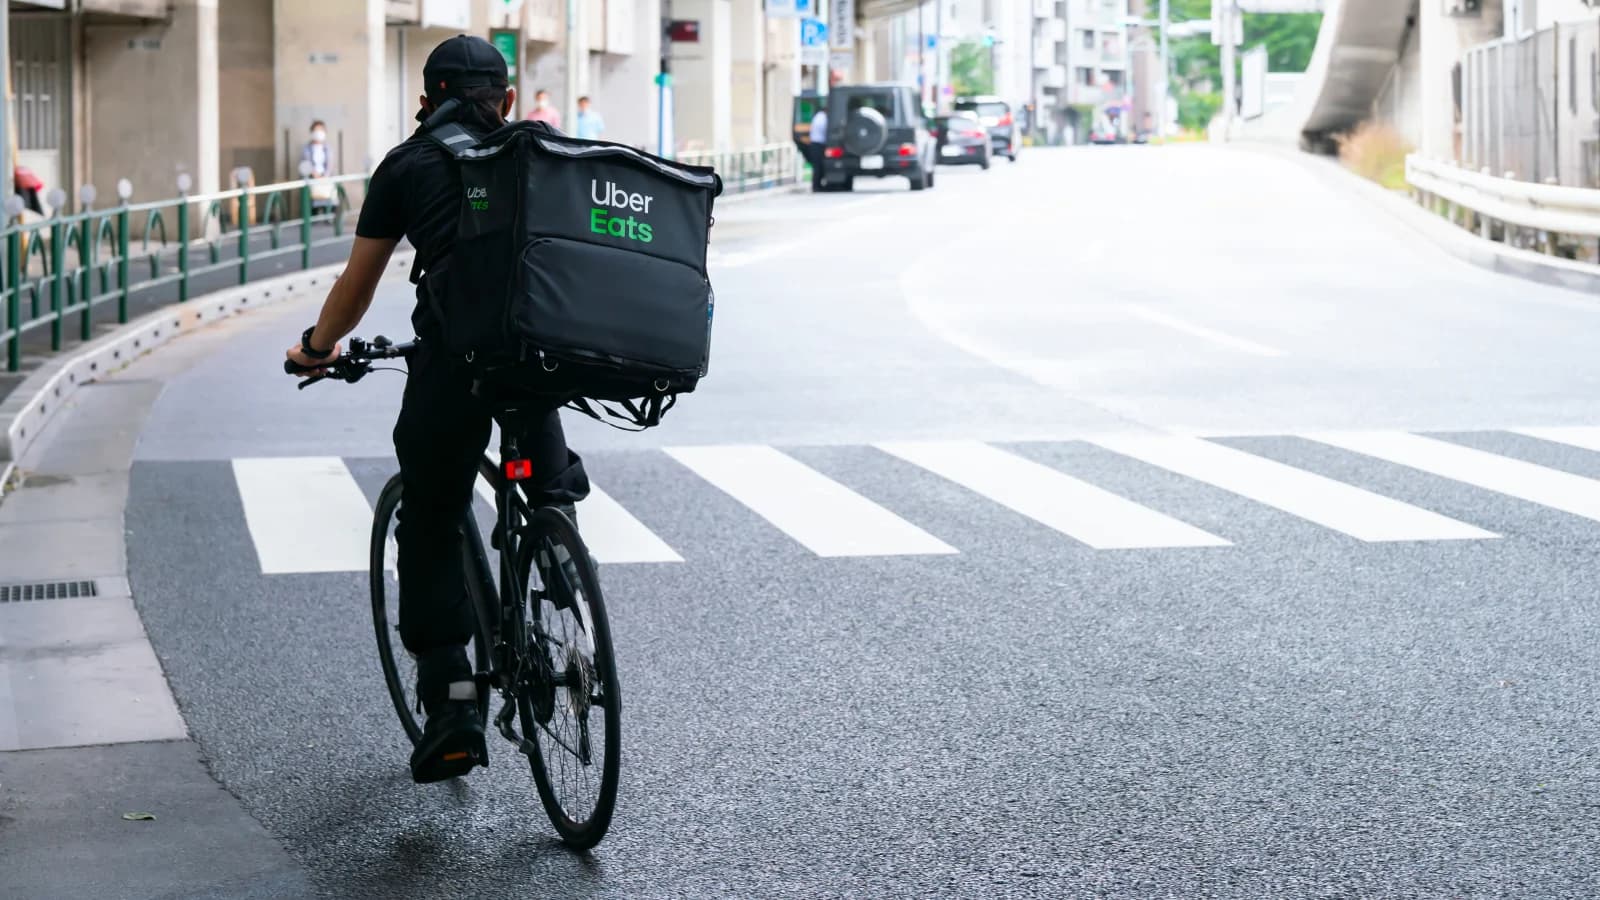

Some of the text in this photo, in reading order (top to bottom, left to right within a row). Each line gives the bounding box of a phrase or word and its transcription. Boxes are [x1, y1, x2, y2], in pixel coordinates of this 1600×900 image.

[467, 187, 487, 198] Ube
[591, 179, 653, 214] Uber
[591, 208, 653, 243] Eats
